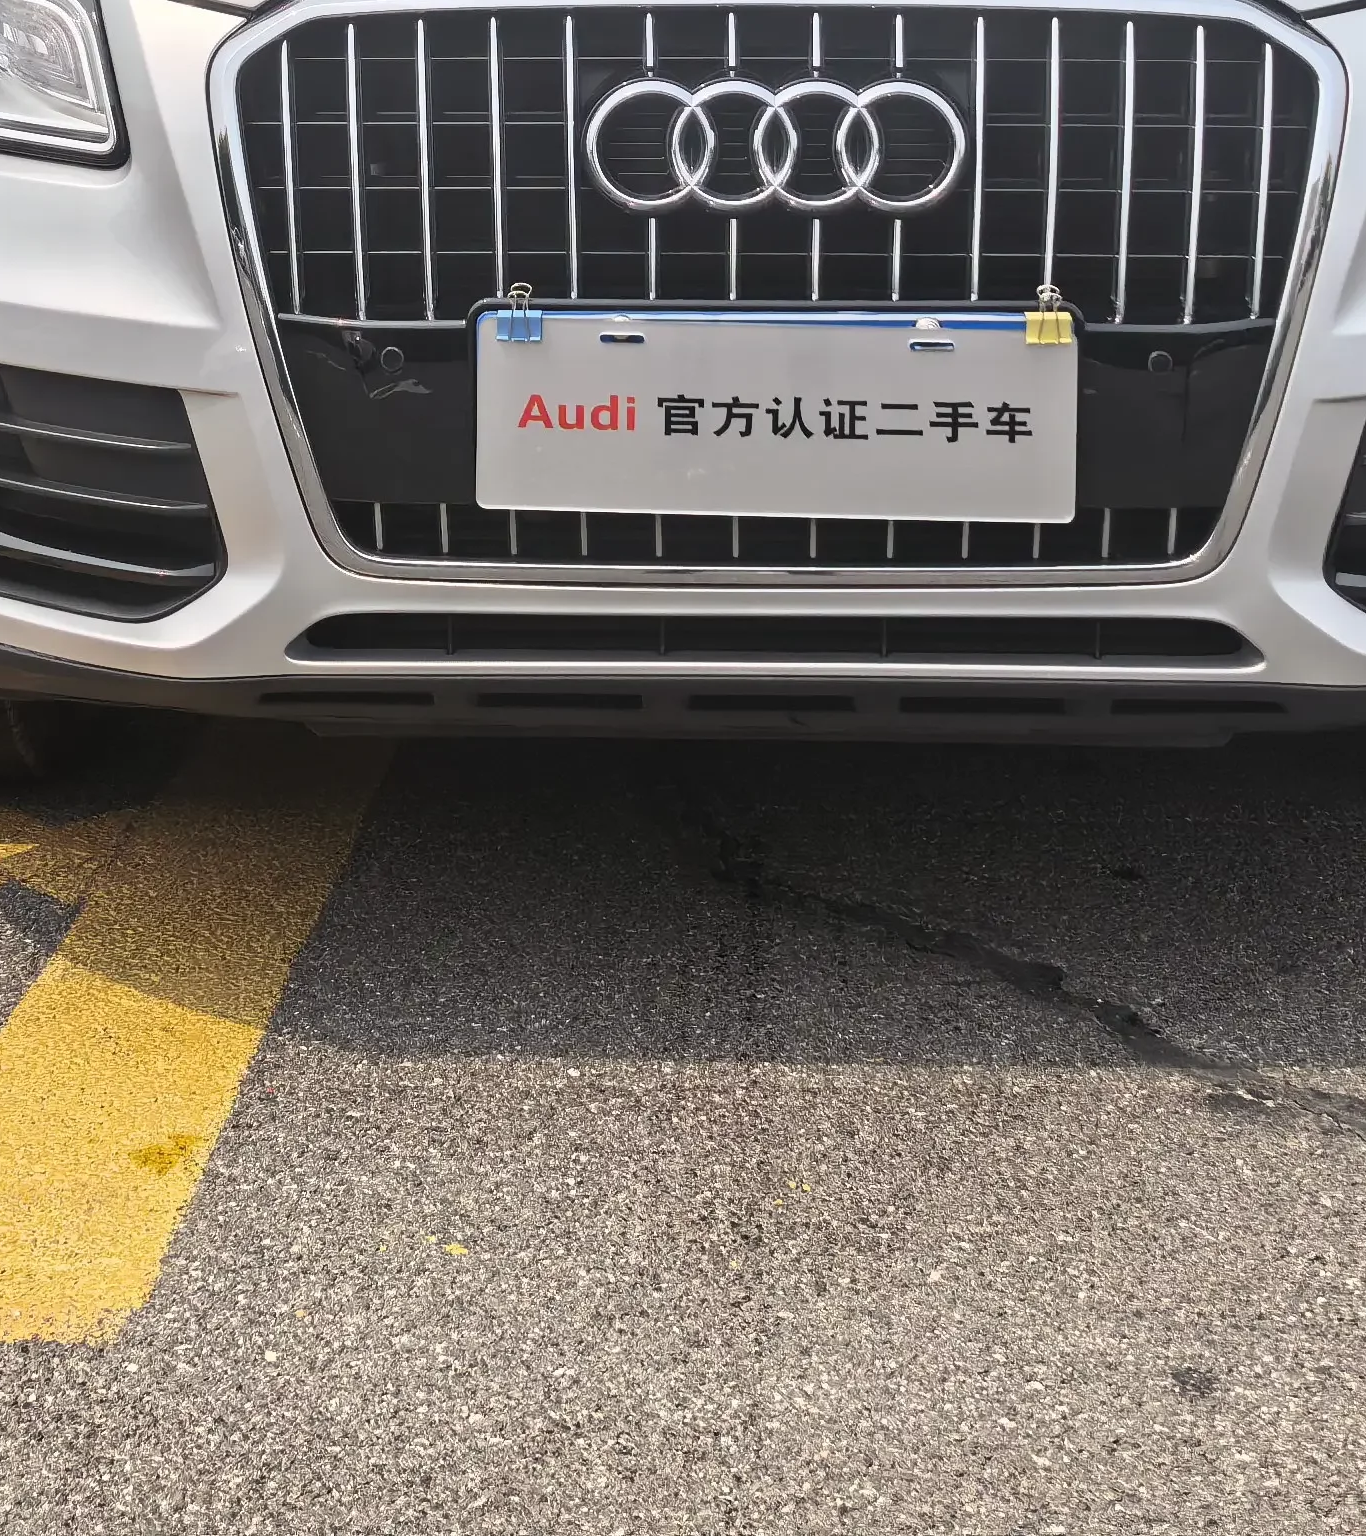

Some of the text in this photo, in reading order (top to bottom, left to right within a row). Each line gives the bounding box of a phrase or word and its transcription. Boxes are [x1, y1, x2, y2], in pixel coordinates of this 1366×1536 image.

[519, 393, 1034, 444] Audi 官方认证二手车
